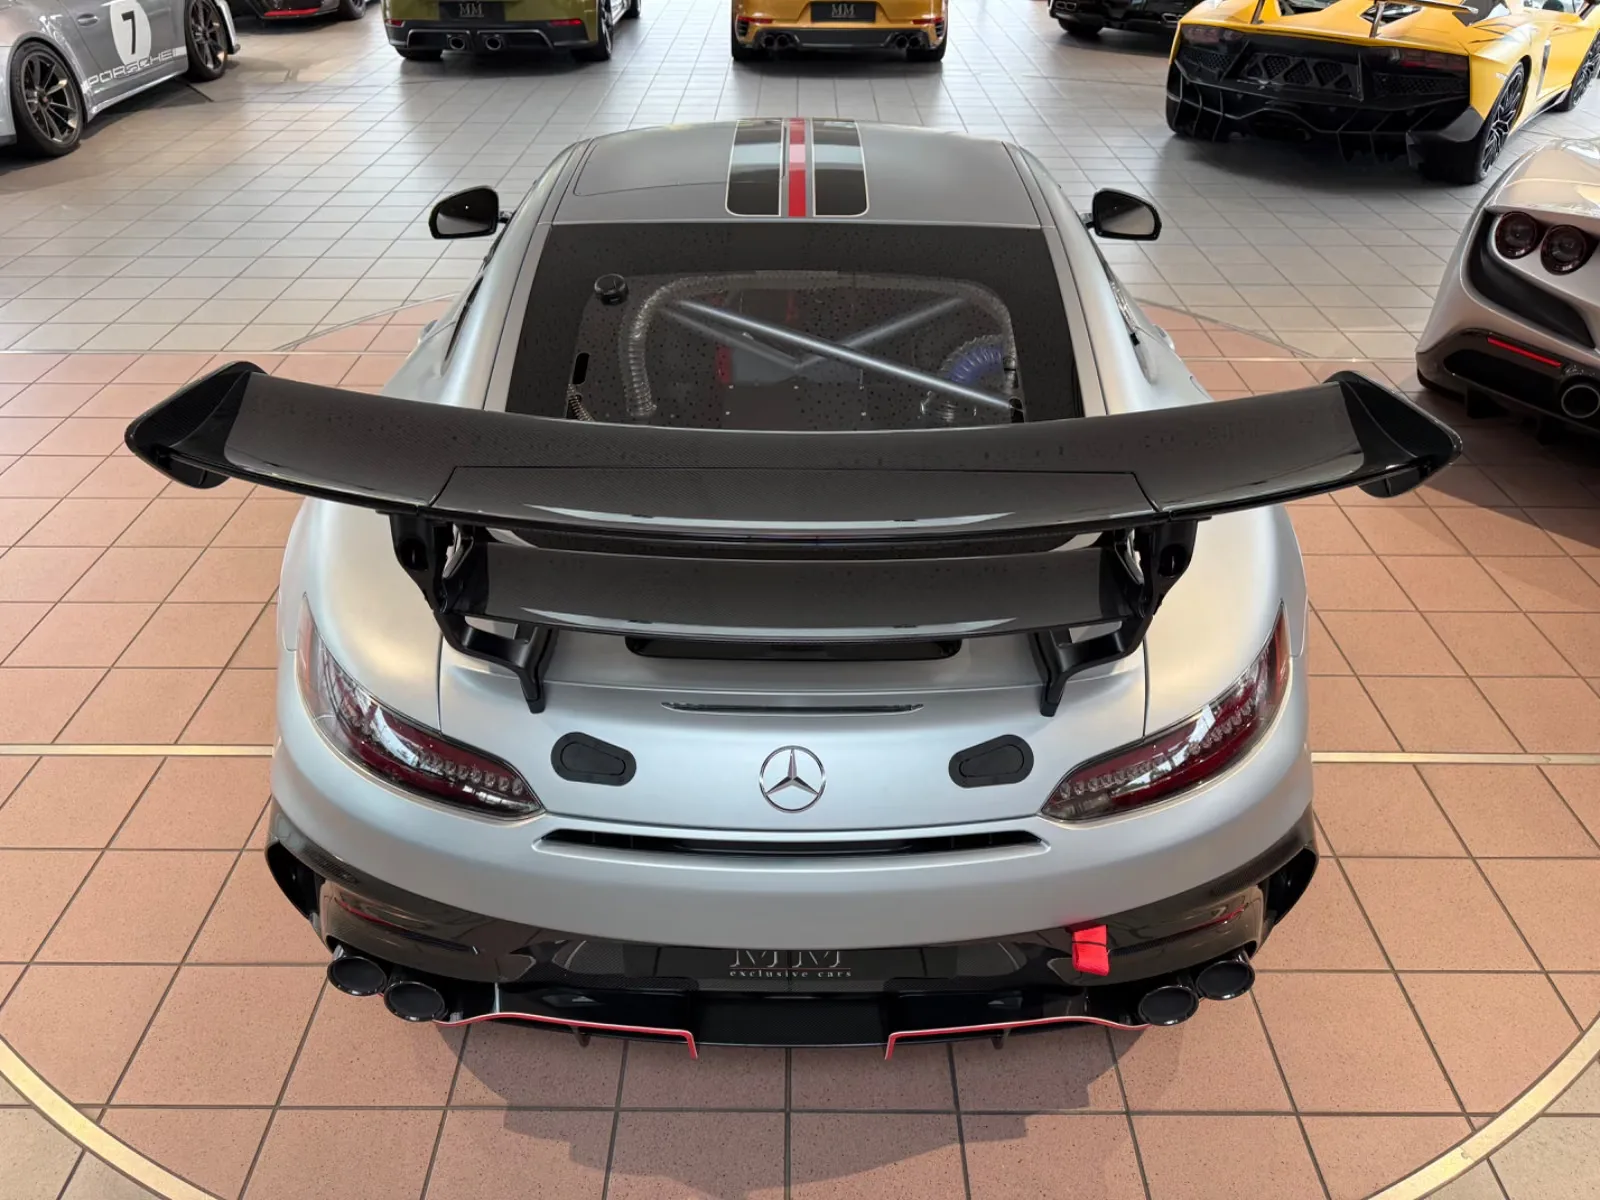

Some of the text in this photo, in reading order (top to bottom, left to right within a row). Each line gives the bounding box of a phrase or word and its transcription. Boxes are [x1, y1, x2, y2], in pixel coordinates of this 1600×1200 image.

[459, 3, 482, 15] MM
[832, 3, 855, 15] MM
[121, 9, 136, 55] 7
[88, 48, 173, 88] PORSCHE
[729, 969, 852, 978] exclusive cars
